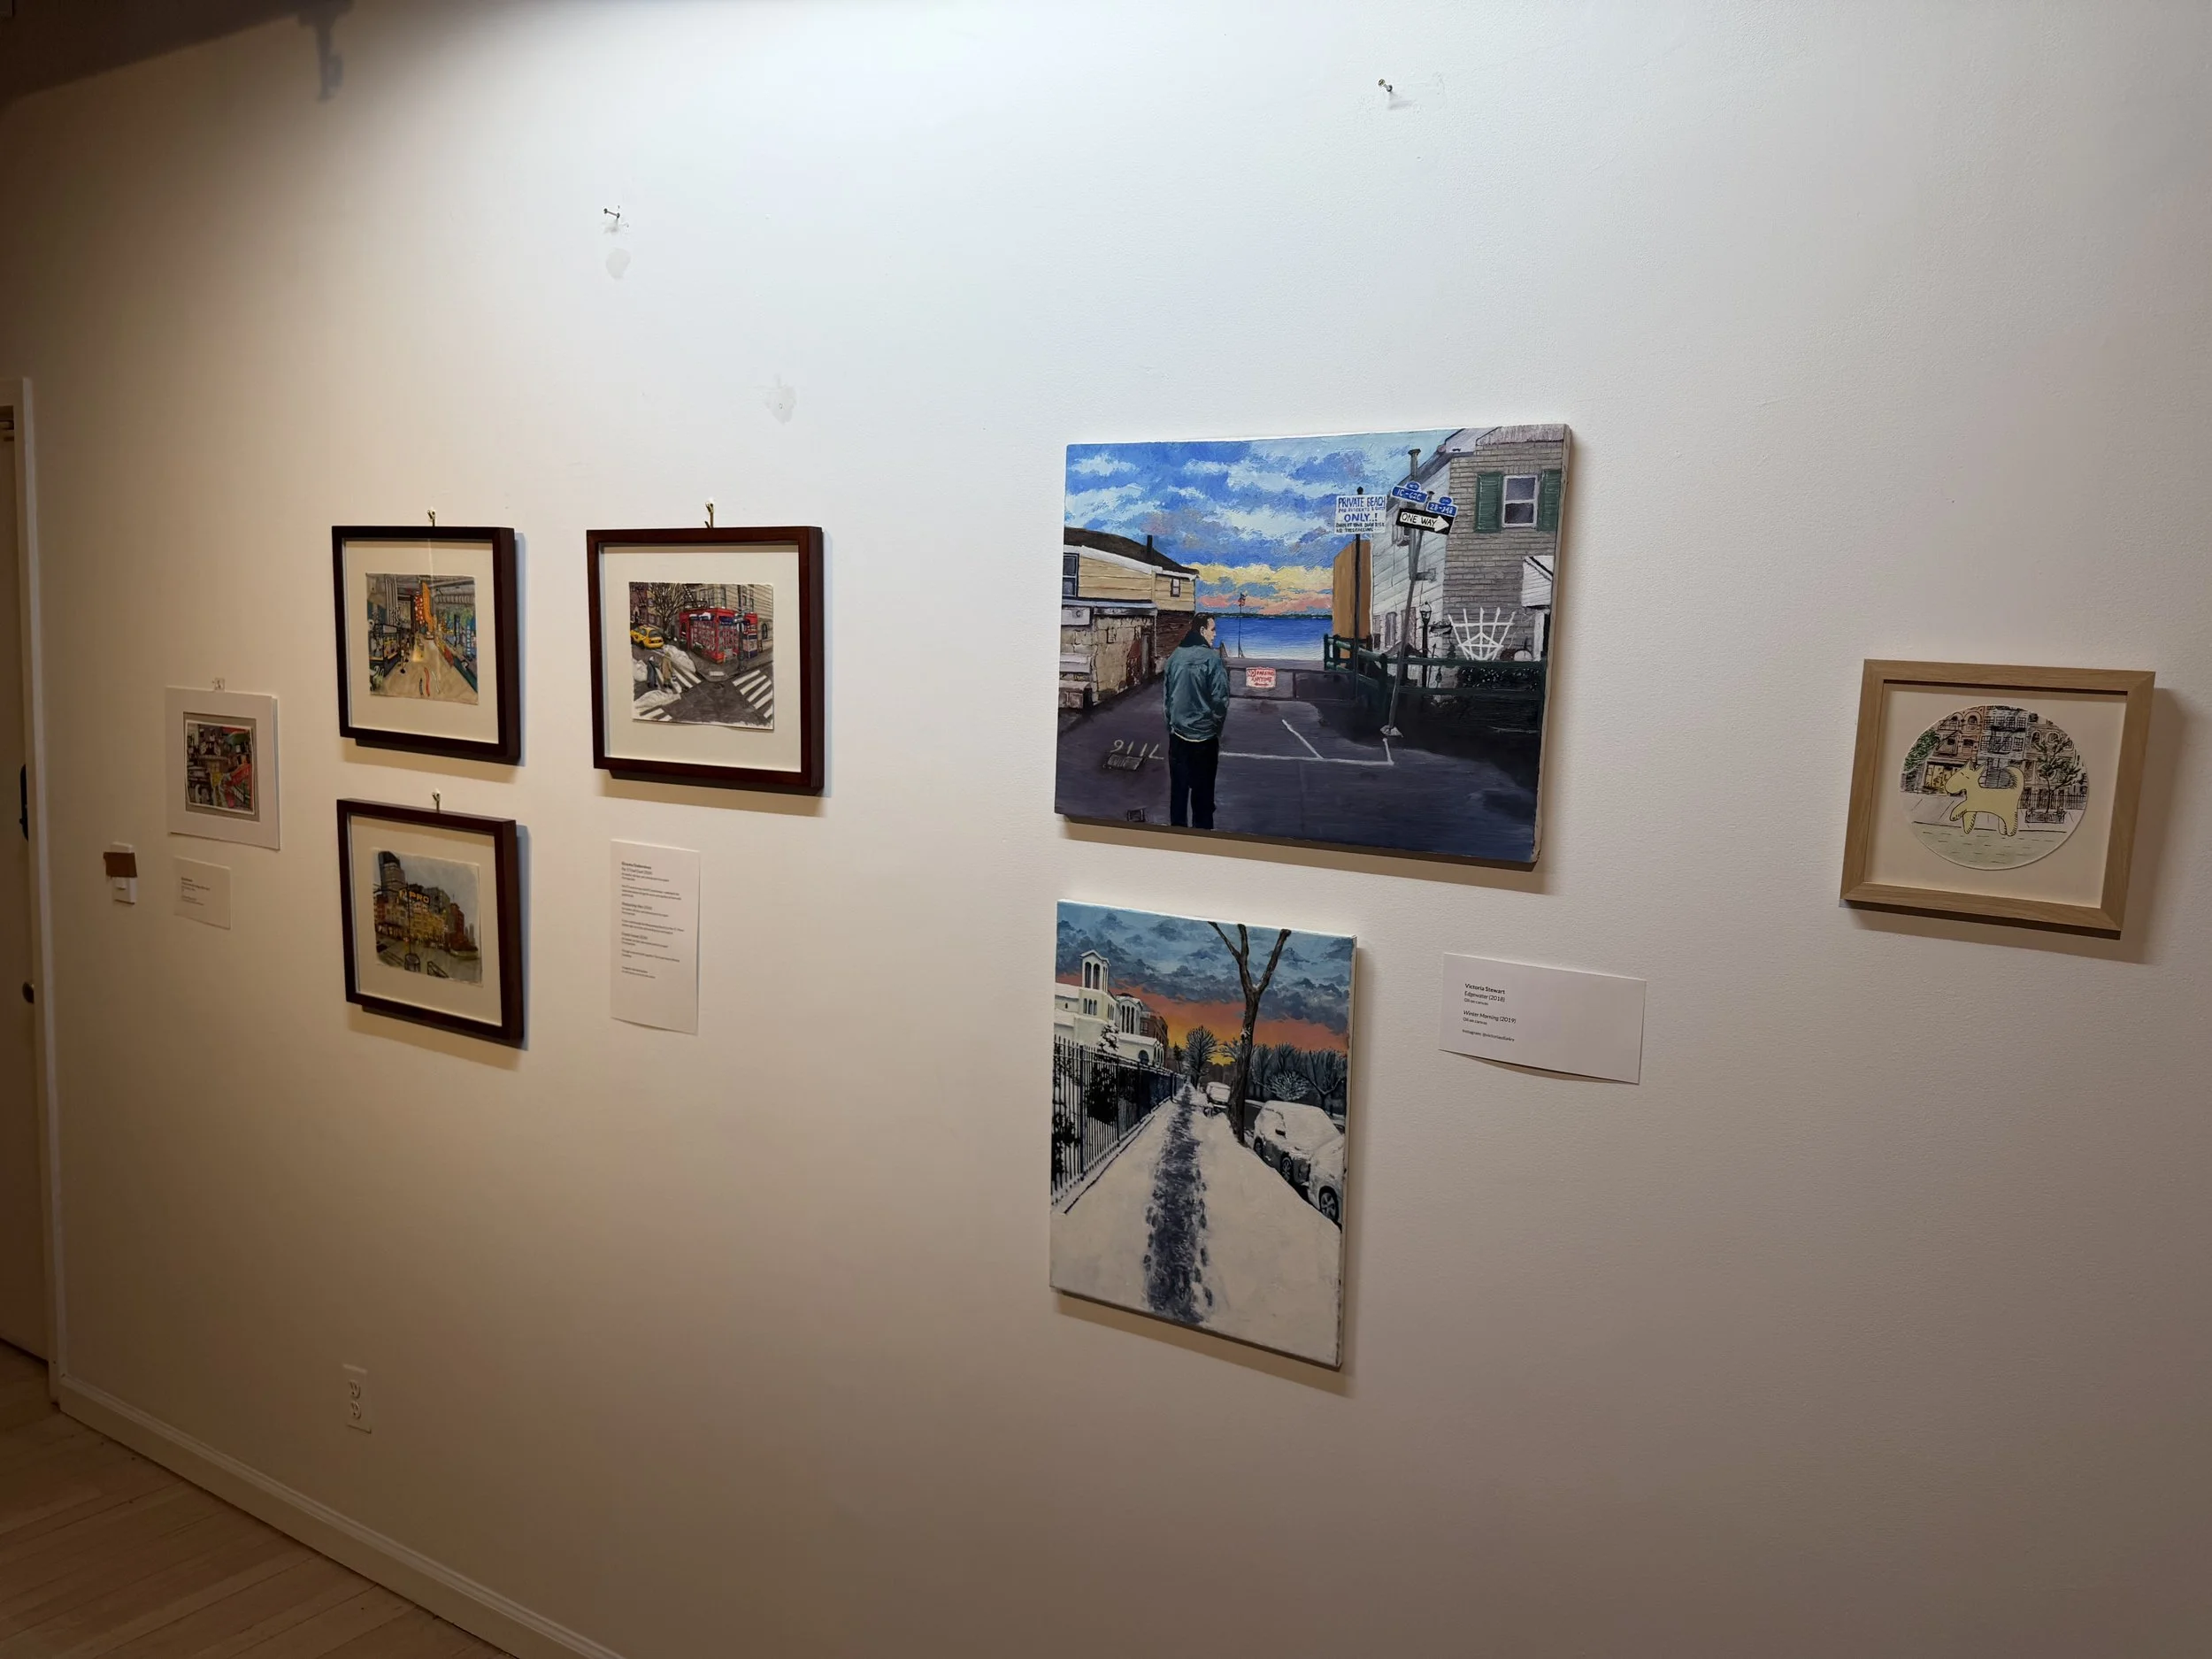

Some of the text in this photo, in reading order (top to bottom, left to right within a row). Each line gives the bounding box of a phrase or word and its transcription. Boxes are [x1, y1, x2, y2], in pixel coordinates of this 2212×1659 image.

[1338, 496, 1386, 508] PRIVATE BEACH
[1402, 512, 1437, 527] ONE WAY
[1464, 990, 1488, 999] Edgewater
[1485, 986, 1505, 995] Stewart
[1479, 1012, 1499, 1022] Morning
